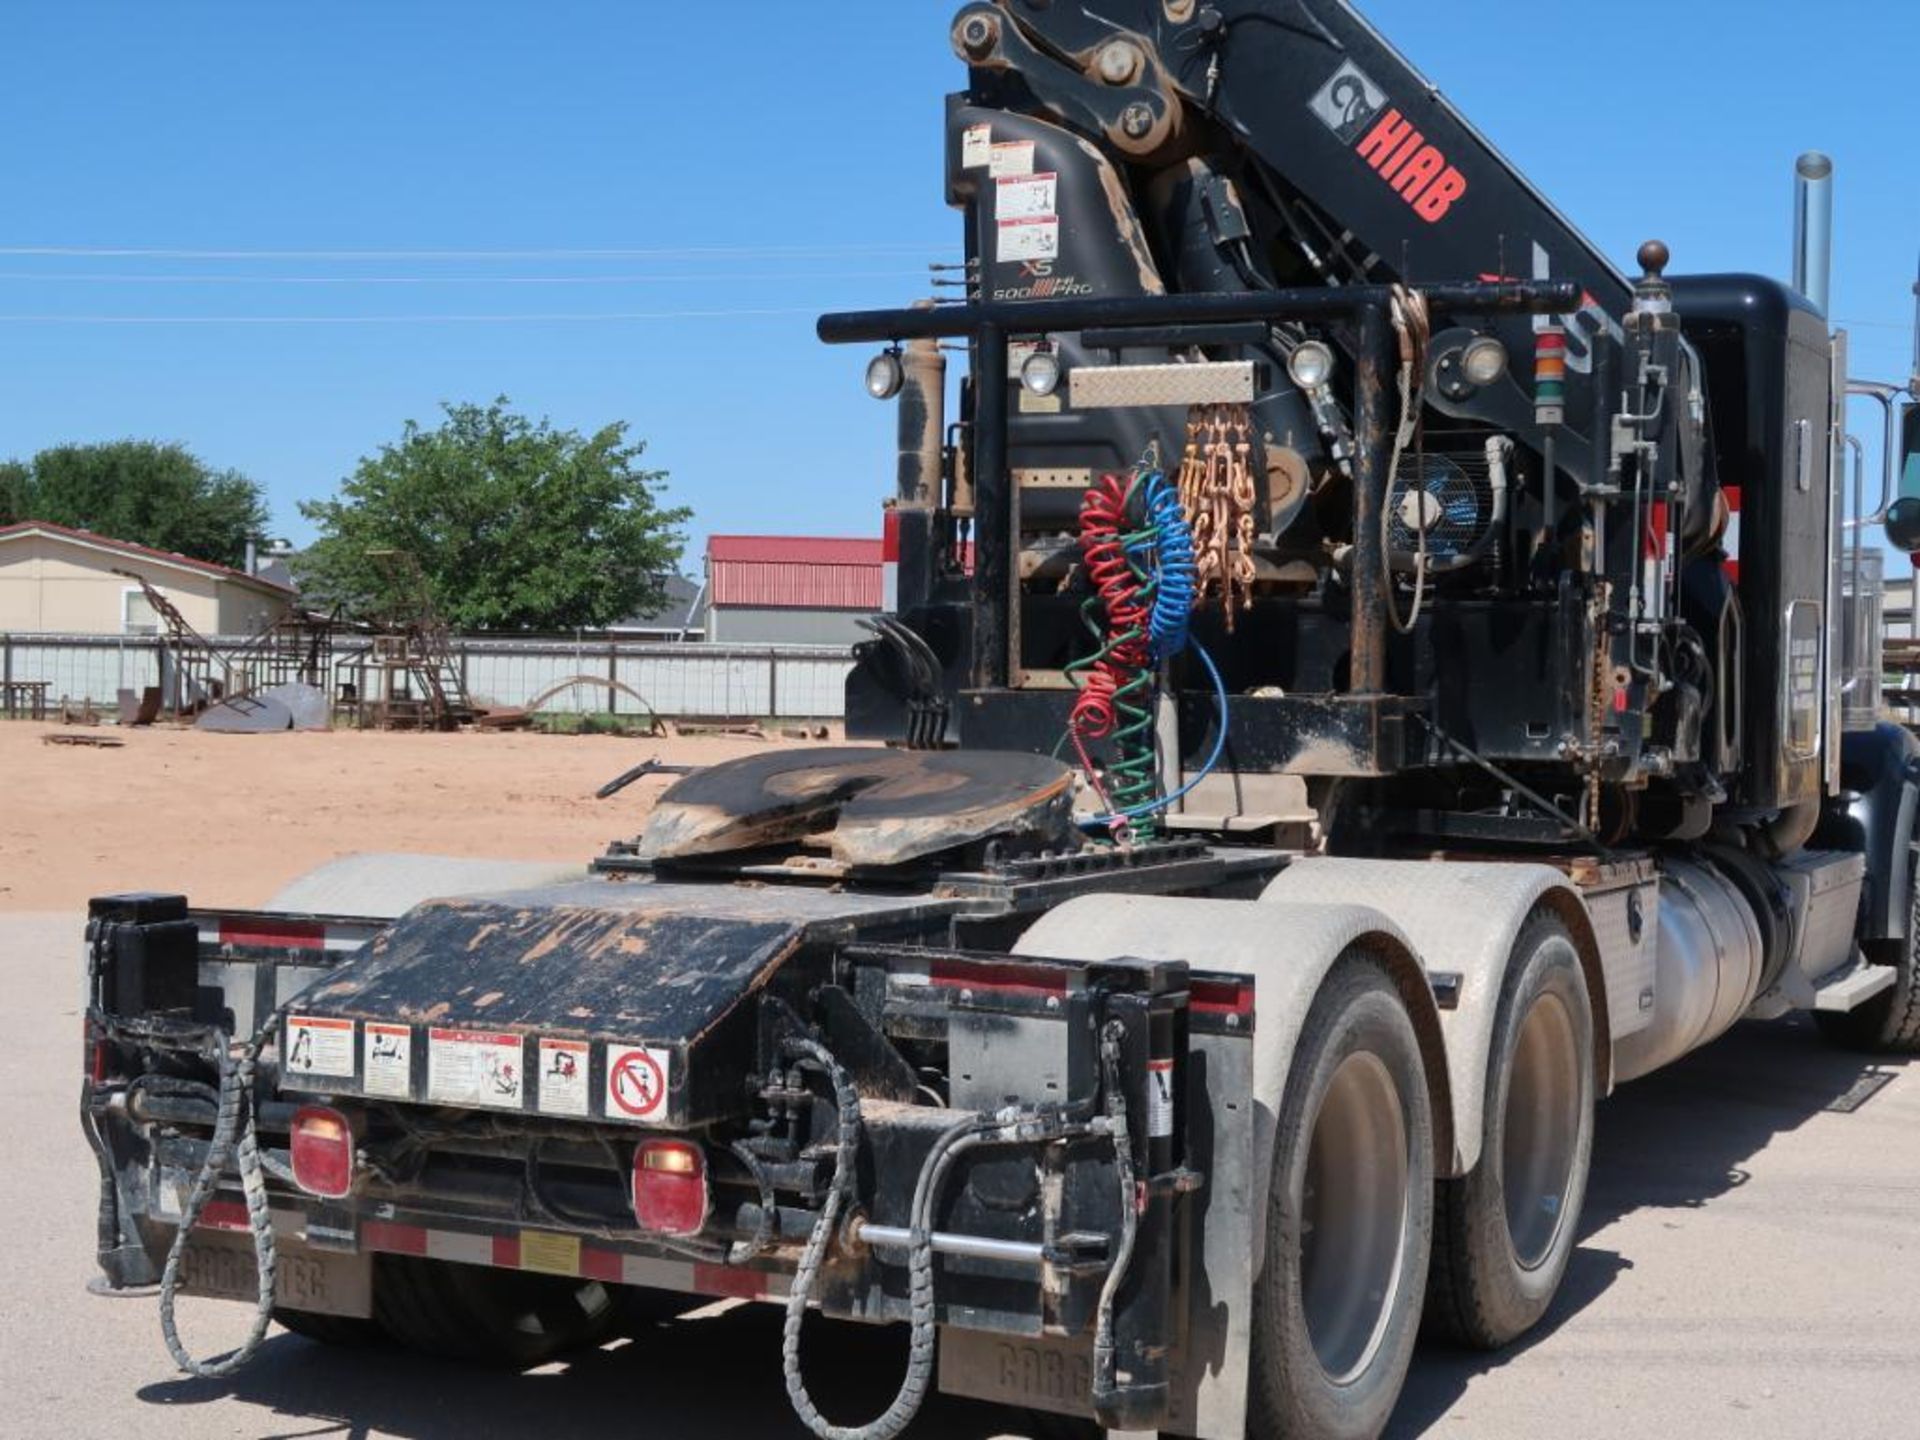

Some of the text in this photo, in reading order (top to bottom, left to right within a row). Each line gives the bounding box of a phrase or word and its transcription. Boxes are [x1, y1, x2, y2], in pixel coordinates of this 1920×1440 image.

[1355, 108, 1467, 223] HIAB
[1018, 260, 1053, 278] XS
[1051, 281, 1093, 296] PRO
[182, 1245, 327, 1298] CARGTEC
